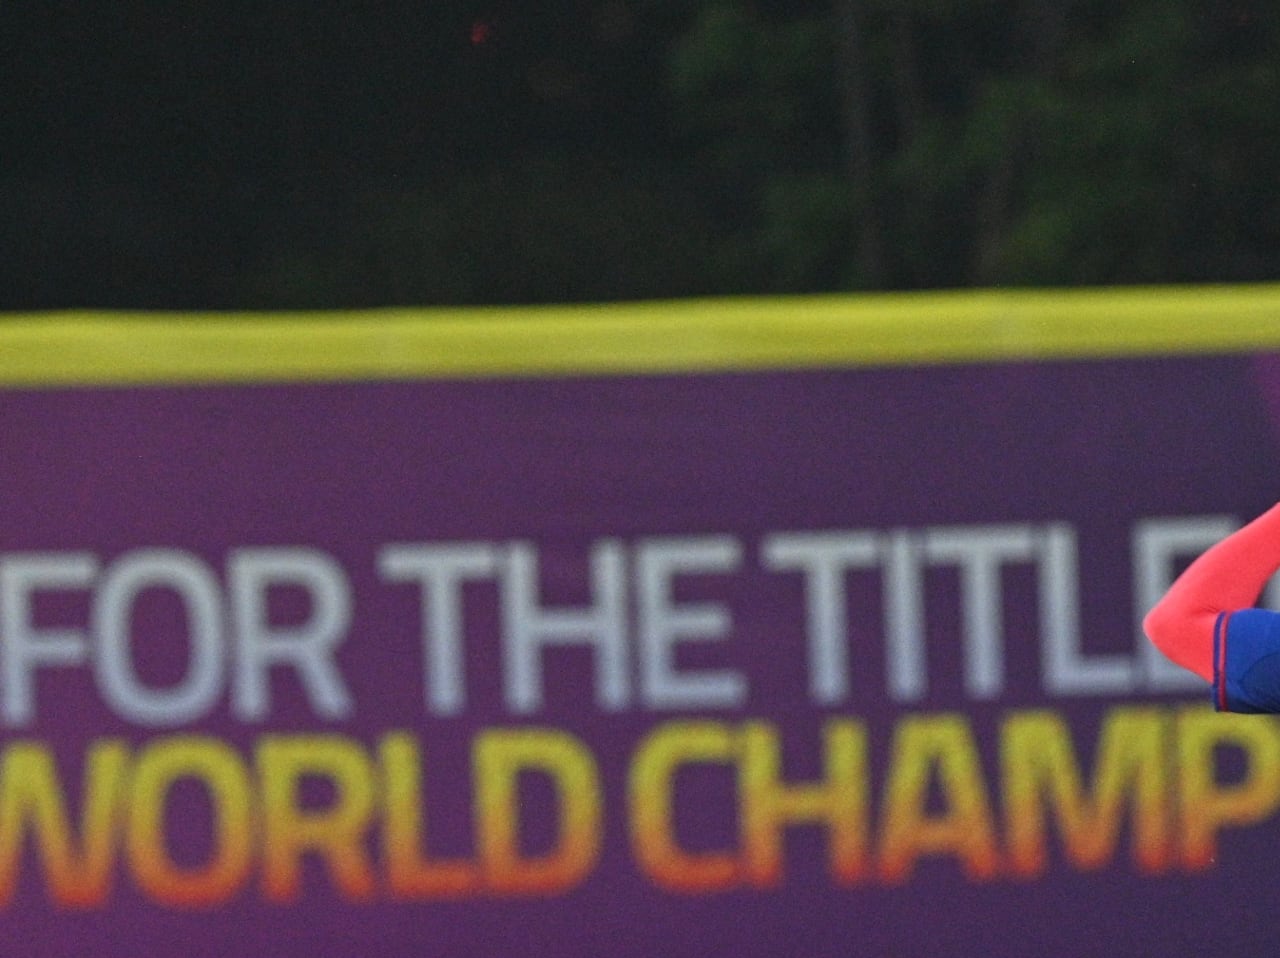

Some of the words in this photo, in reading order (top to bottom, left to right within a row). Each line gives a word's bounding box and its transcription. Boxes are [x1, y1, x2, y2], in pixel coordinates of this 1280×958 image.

[0, 549, 351, 726] FOR
[379, 539, 747, 711] THE
[763, 516, 1240, 702] TITLE
[0, 728, 602, 909] WORLD
